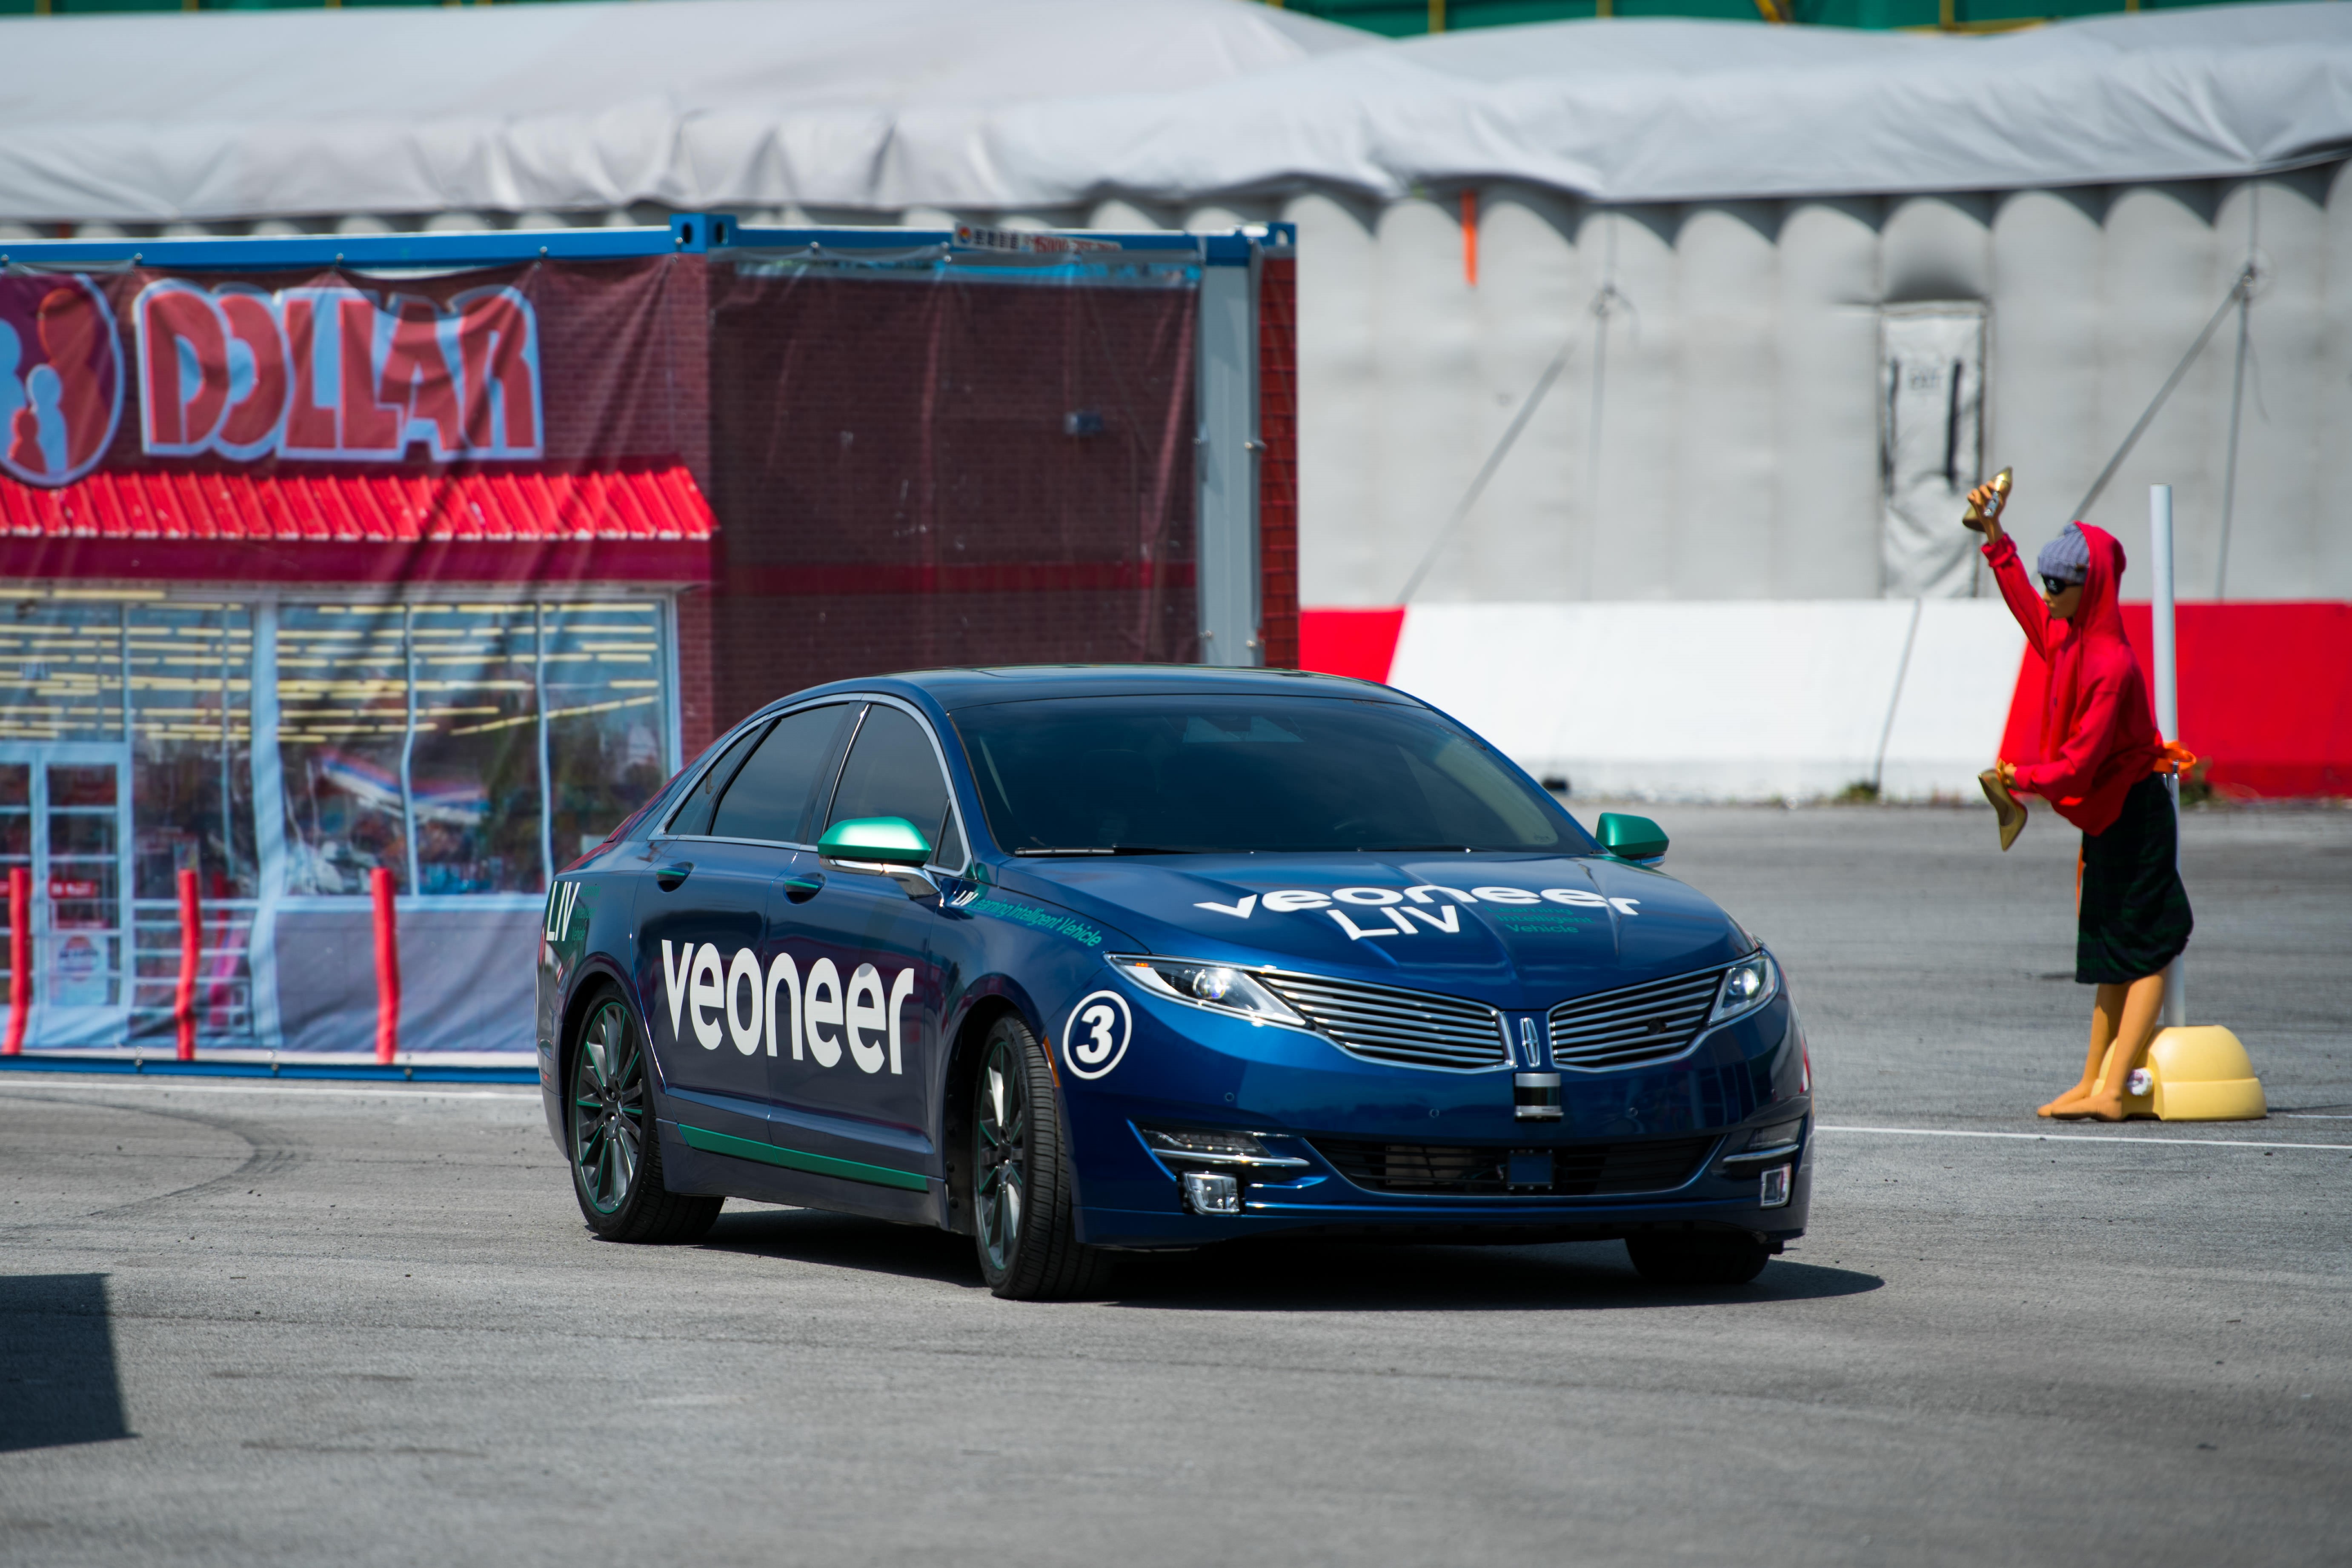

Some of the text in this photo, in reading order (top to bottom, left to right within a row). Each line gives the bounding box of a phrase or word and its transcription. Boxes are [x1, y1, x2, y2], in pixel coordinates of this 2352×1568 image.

[134, 278, 544, 462] DOLLAR
[546, 881, 581, 941] LIV
[951, 890, 1102, 947] LIV Learning Intelligent Vehicle
[1193, 885, 1640, 919] veoneer
[1326, 905, 1460, 940] LIV
[1484, 906, 1574, 915] Learning
[1495, 915, 1595, 924] Intelligent
[1505, 924, 1579, 933] Vehicle
[661, 939, 914, 1075] veoneer
[1075, 1004, 1114, 1064] 3
